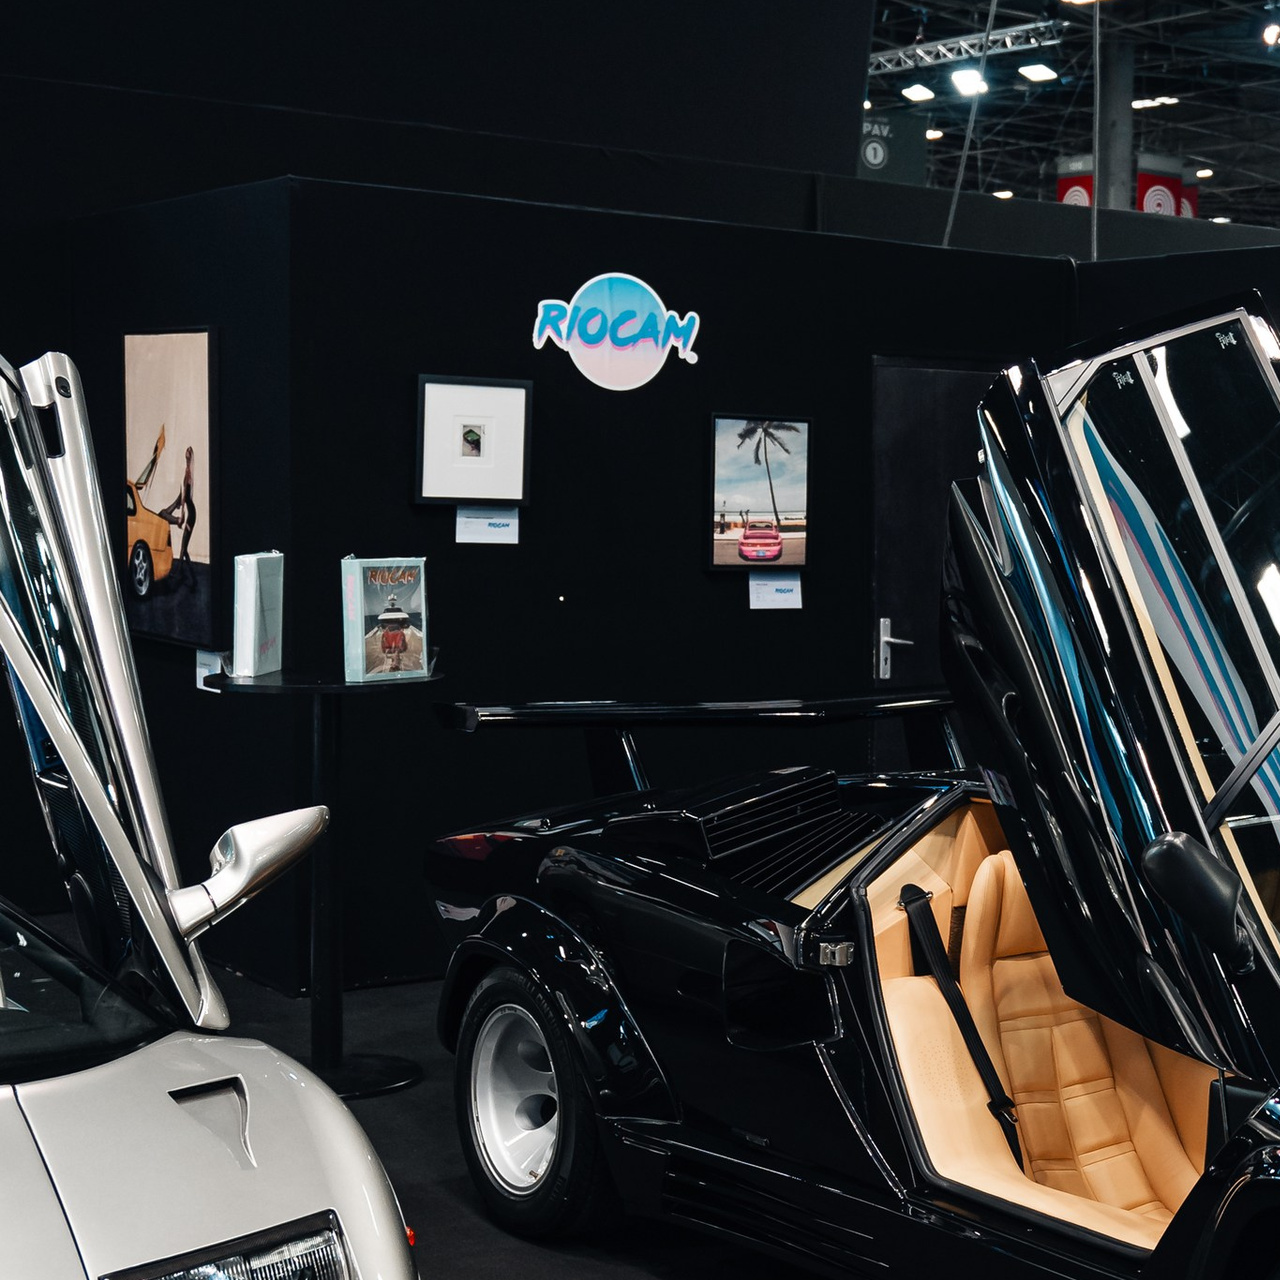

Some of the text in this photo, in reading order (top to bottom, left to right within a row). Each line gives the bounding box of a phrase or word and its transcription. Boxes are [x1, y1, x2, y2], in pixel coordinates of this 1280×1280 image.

[863, 122, 893, 138] PAV.
[537, 302, 696, 354] RIOCAM
[367, 569, 417, 586] RIOCAM
